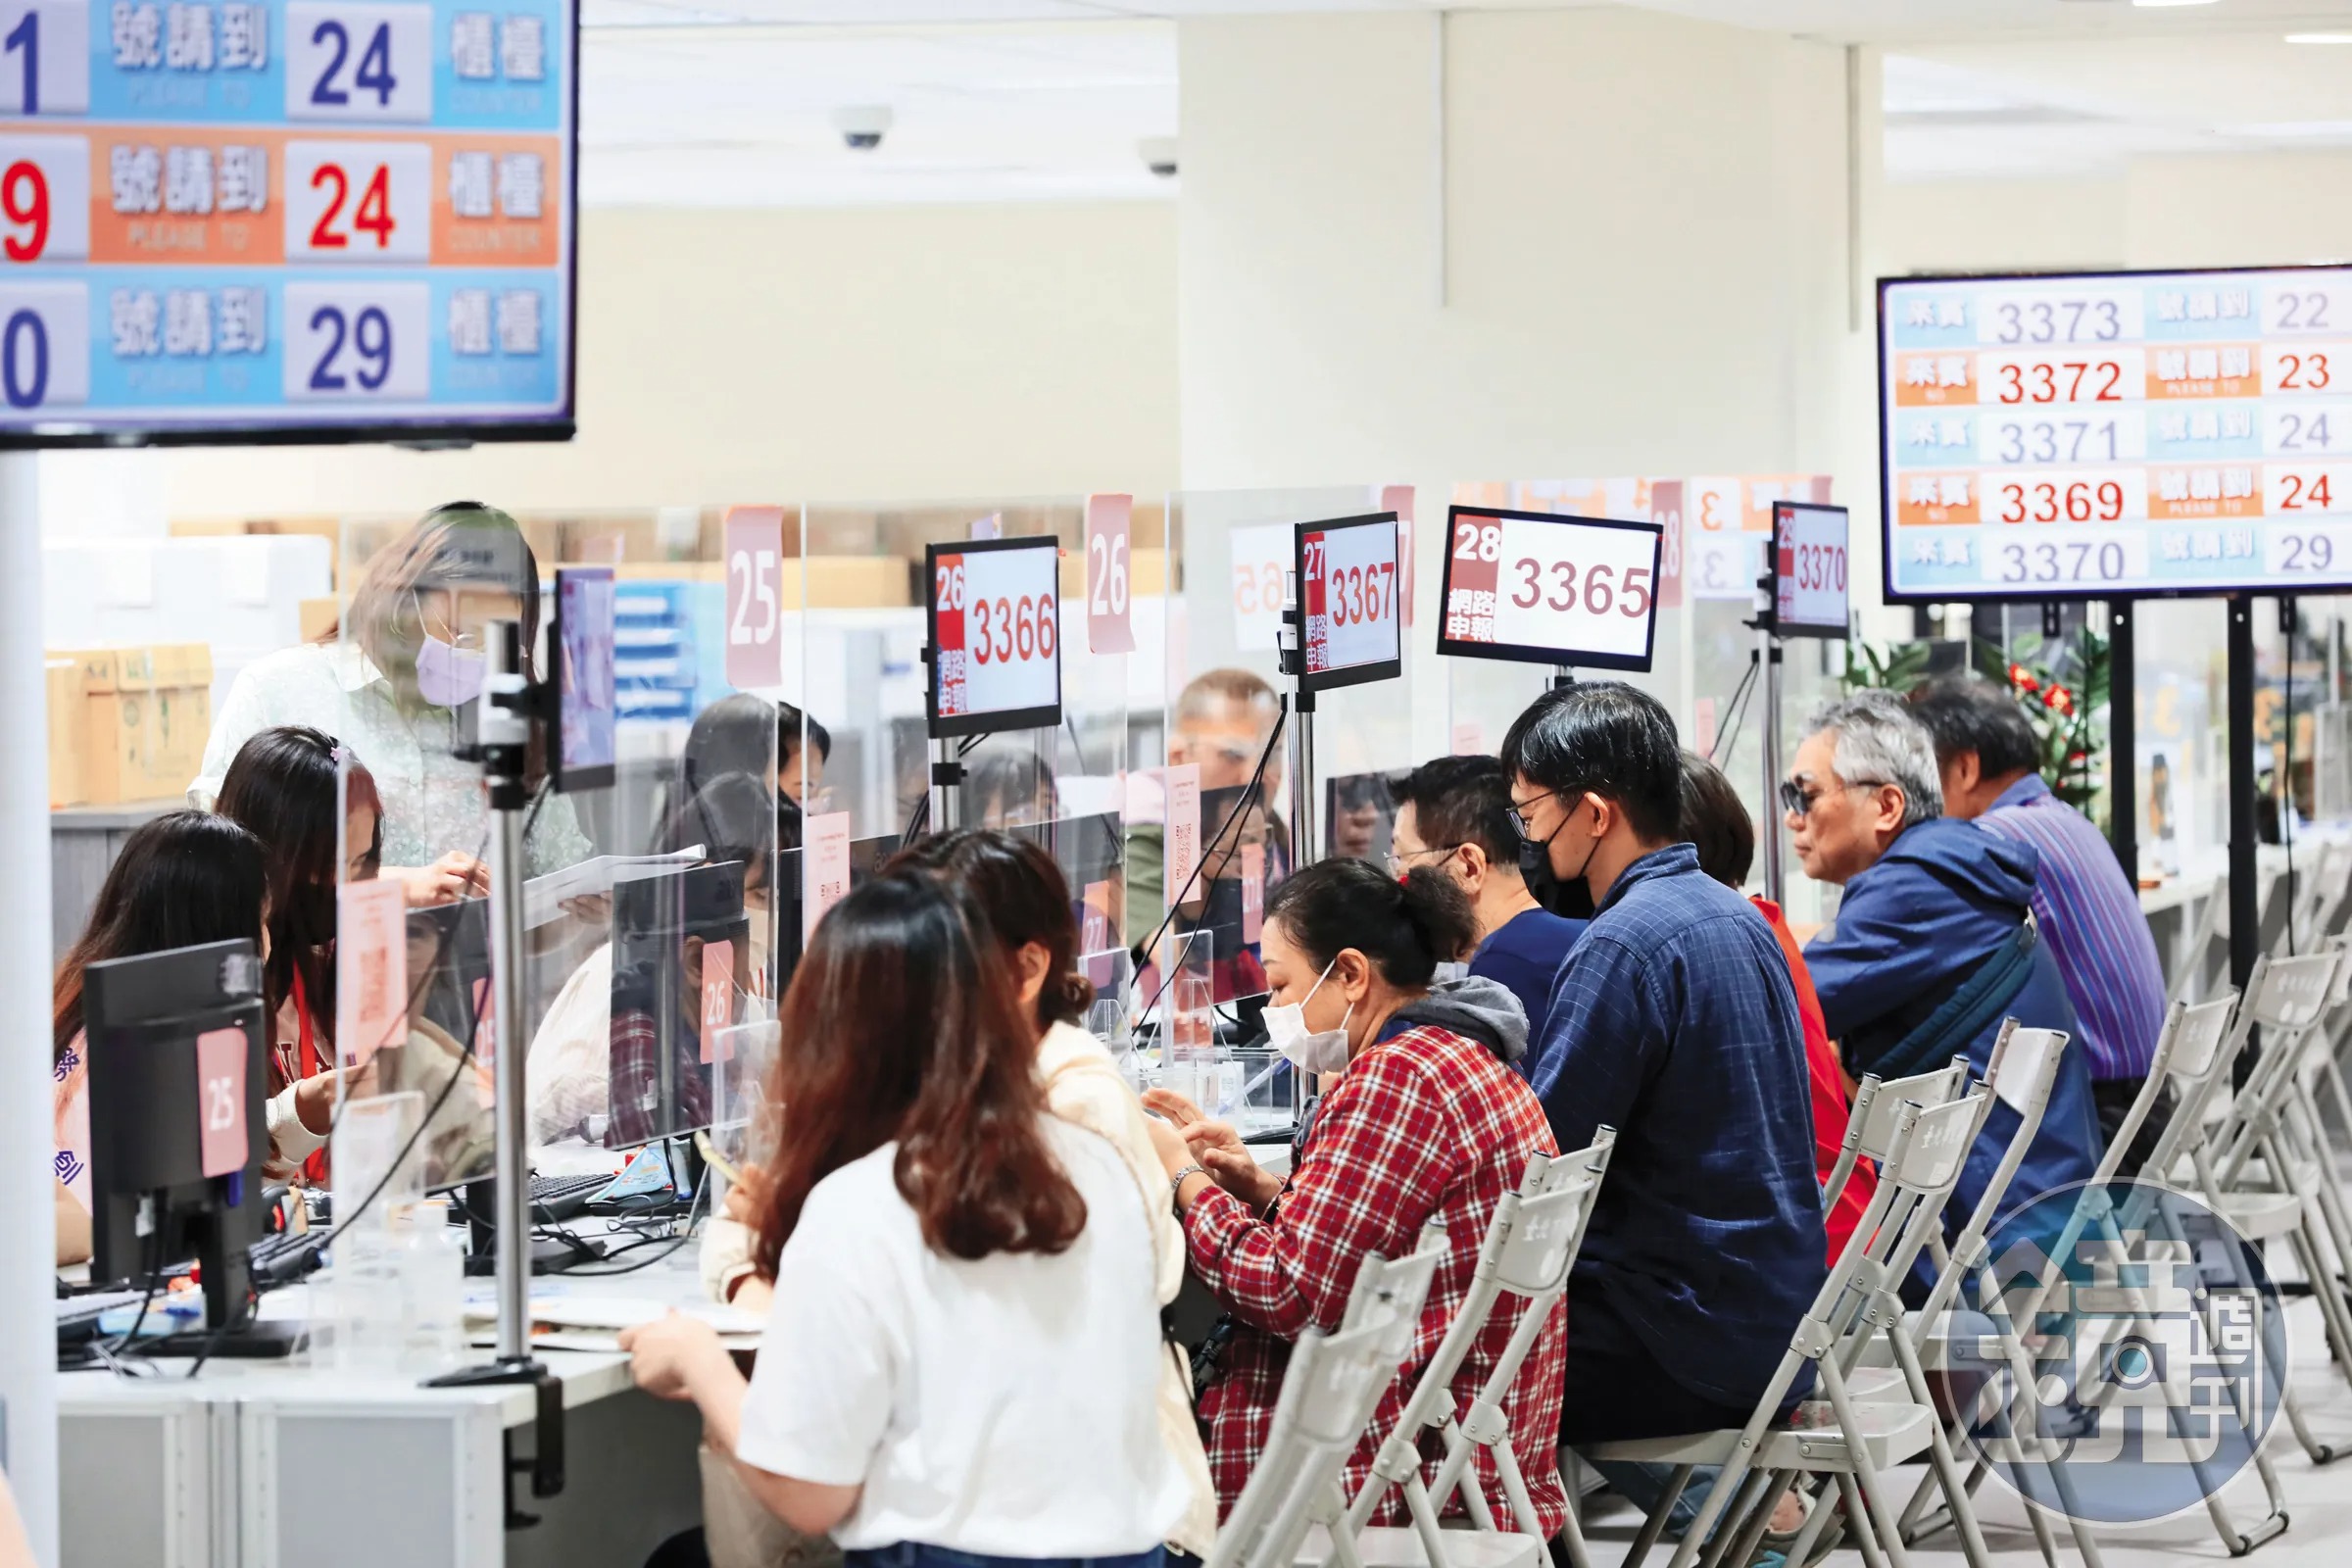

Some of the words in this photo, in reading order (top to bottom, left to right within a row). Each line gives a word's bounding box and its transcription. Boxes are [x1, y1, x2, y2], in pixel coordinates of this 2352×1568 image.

[310, 20, 396, 106] 24
[309, 164, 395, 249] 24
[1998, 300, 2120, 343] 3373
[2277, 292, 2329, 328] 22
[309, 306, 393, 391] 29
[1998, 362, 2123, 403] 3372
[2278, 354, 2329, 389] 23
[1999, 420, 2118, 464] 3371
[2279, 413, 2331, 449] 24
[2001, 481, 2124, 523] 3369
[2280, 474, 2332, 509] 24
[1303, 541, 1325, 581] 27
[1454, 523, 1501, 563] 28
[2002, 542, 2125, 582] 3370
[2281, 534, 2333, 570] 29
[937, 564, 965, 612] 26
[1091, 533, 1127, 617] 26
[1511, 558, 1651, 618] 3365
[1799, 545, 1846, 593] 3370
[730, 550, 776, 646] 25
[1332, 562, 1395, 627] 3367
[1448, 588, 1495, 616] 網路
[974, 593, 1055, 665] 3366
[1447, 615, 1494, 642] 申報
[1306, 643, 1329, 671] 申報
[706, 981, 725, 1025] 26
[208, 1076, 235, 1131] 25
